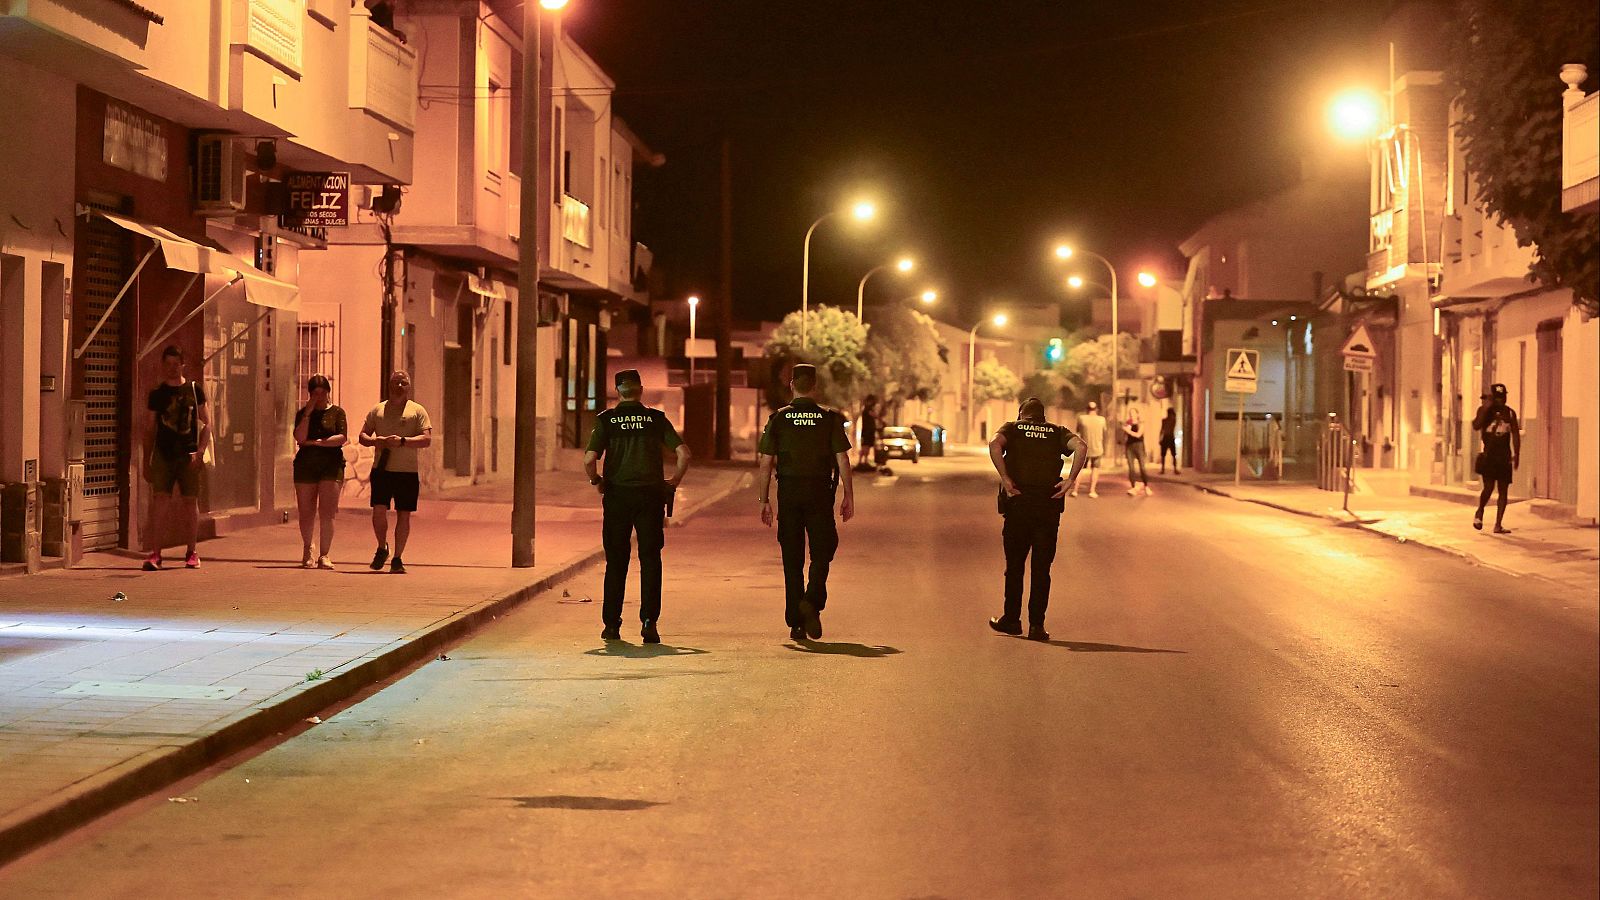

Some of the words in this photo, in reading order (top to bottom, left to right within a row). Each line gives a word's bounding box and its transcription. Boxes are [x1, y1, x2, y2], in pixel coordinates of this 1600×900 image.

[290, 191, 342, 210] FELIZ
[610, 416, 653, 424] GUARDIA
[620, 422, 644, 430] CIVIL
[1017, 424, 1054, 433] GUARDIA
[1025, 431, 1047, 439] CIVIL
